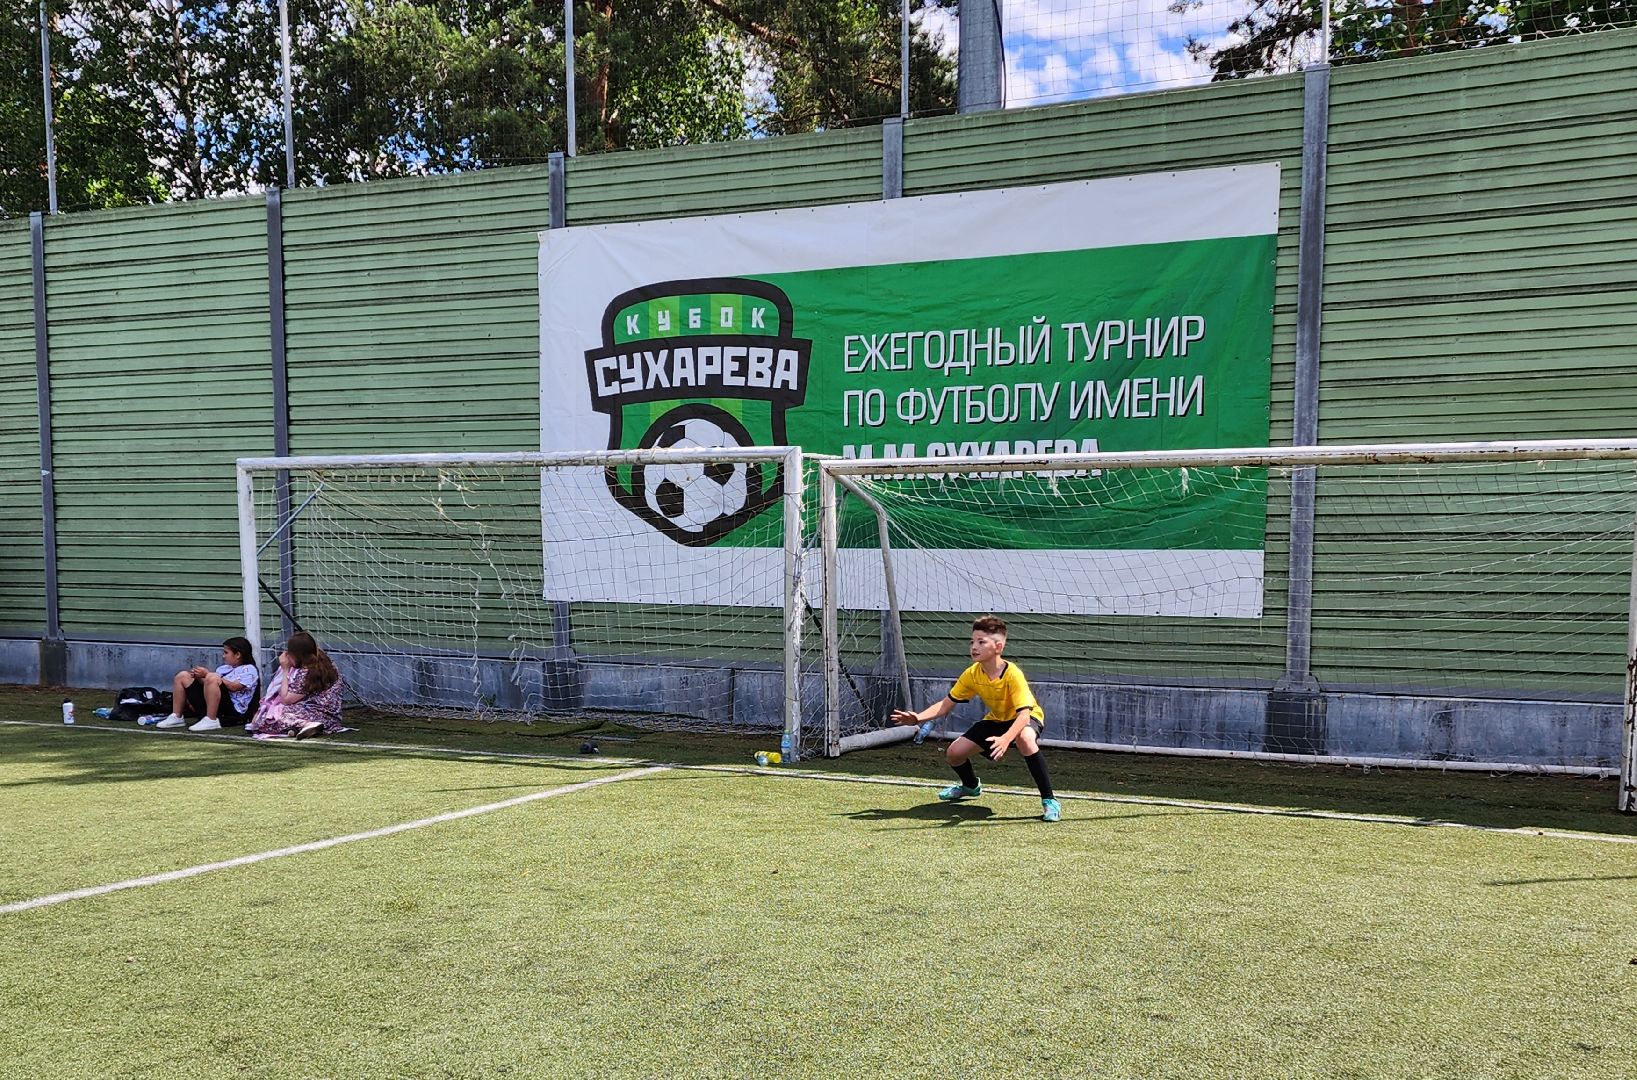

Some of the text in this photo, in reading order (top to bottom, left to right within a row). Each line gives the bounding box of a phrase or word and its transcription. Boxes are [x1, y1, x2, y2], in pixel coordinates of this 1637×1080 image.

[626, 306, 765, 335] КУБОК
[843, 315, 1205, 376] ЕЖЕГОДНЫЙ ТУРНИР
[594, 346, 799, 397] СУХАРЕВА
[843, 375, 1204, 427] ПО ФУТБОЛУ ИМЕНИ
